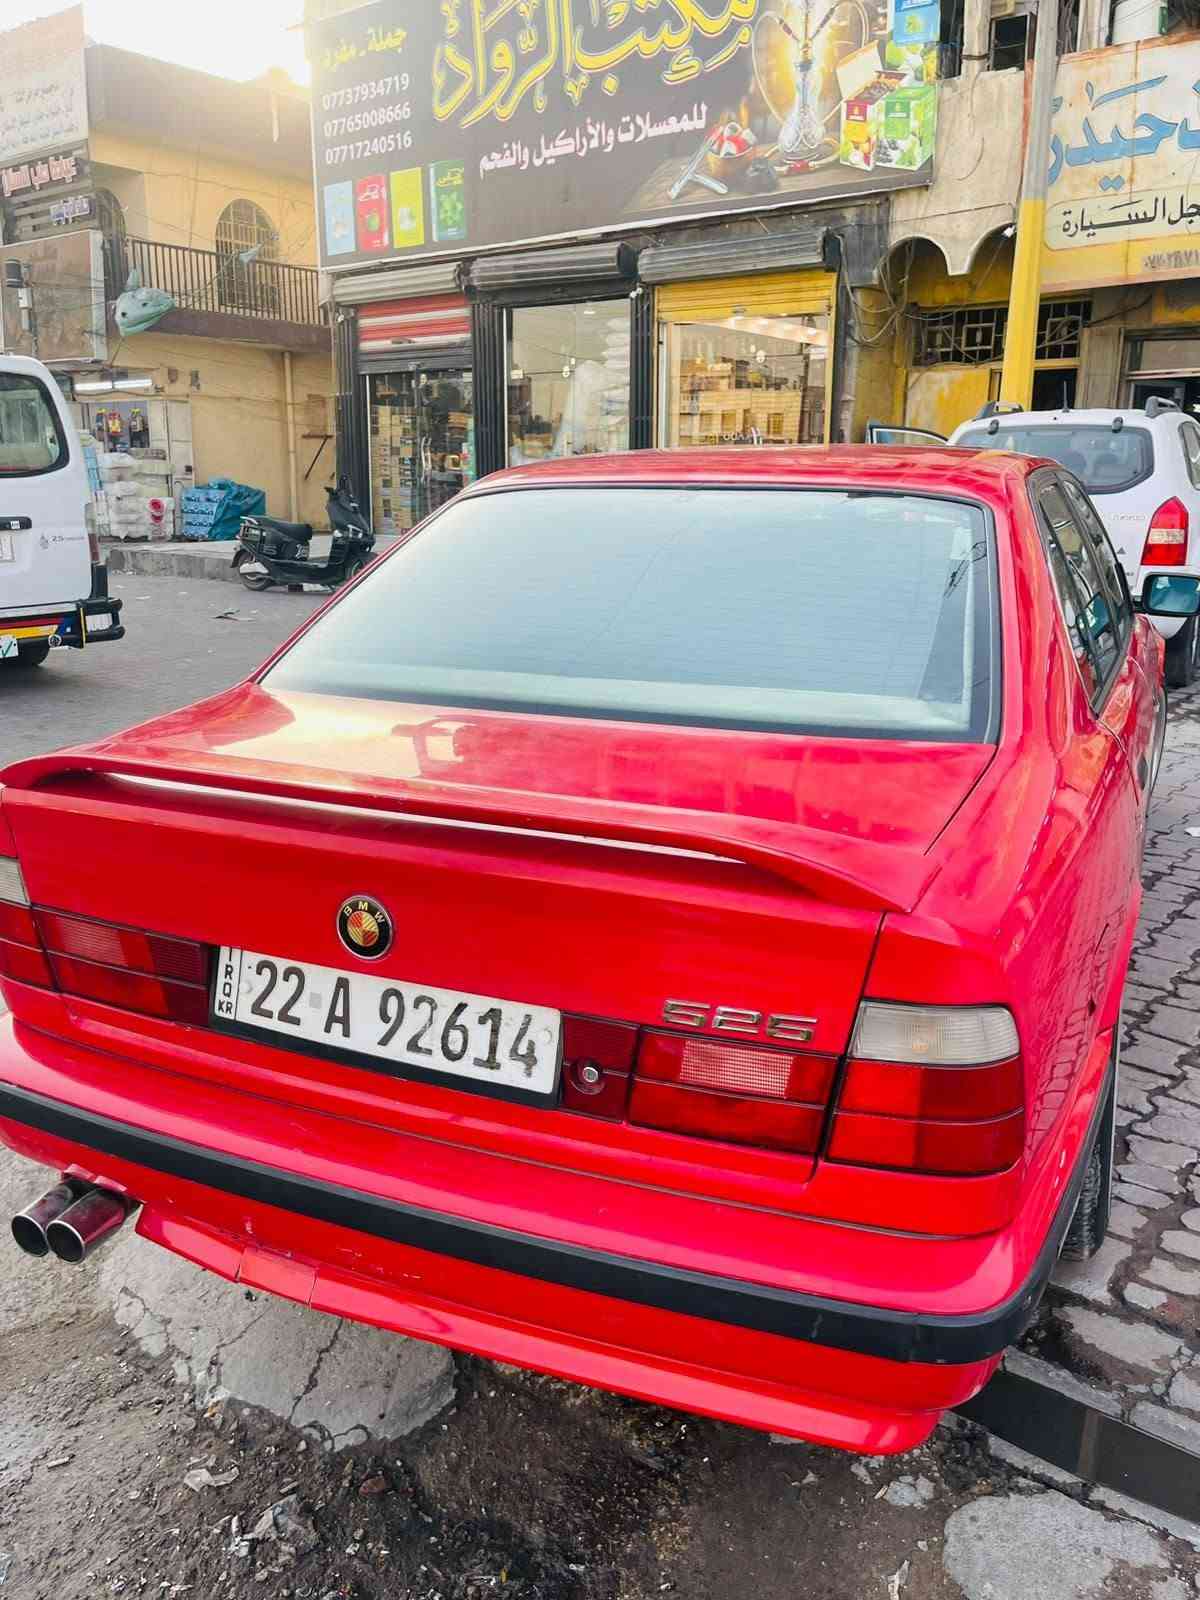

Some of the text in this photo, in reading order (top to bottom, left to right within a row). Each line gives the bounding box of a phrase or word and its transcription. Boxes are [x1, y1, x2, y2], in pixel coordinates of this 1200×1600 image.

[322, 73, 410, 111] 07737934719
[323, 102, 412, 138] 07765008666
[617, 102, 708, 143] للمعسلات
[325, 130, 413, 165] 07717240516
[479, 139, 530, 180] والفحم
[533, 117, 615, 167] والأراكيل
[1062, 195, 1167, 238] السيارة
[342, 900, 385, 924] BMW
[217, 999, 233, 1015] KR
[250, 959, 538, 1078] 22 A 92614
[663, 998, 818, 1042] 525
